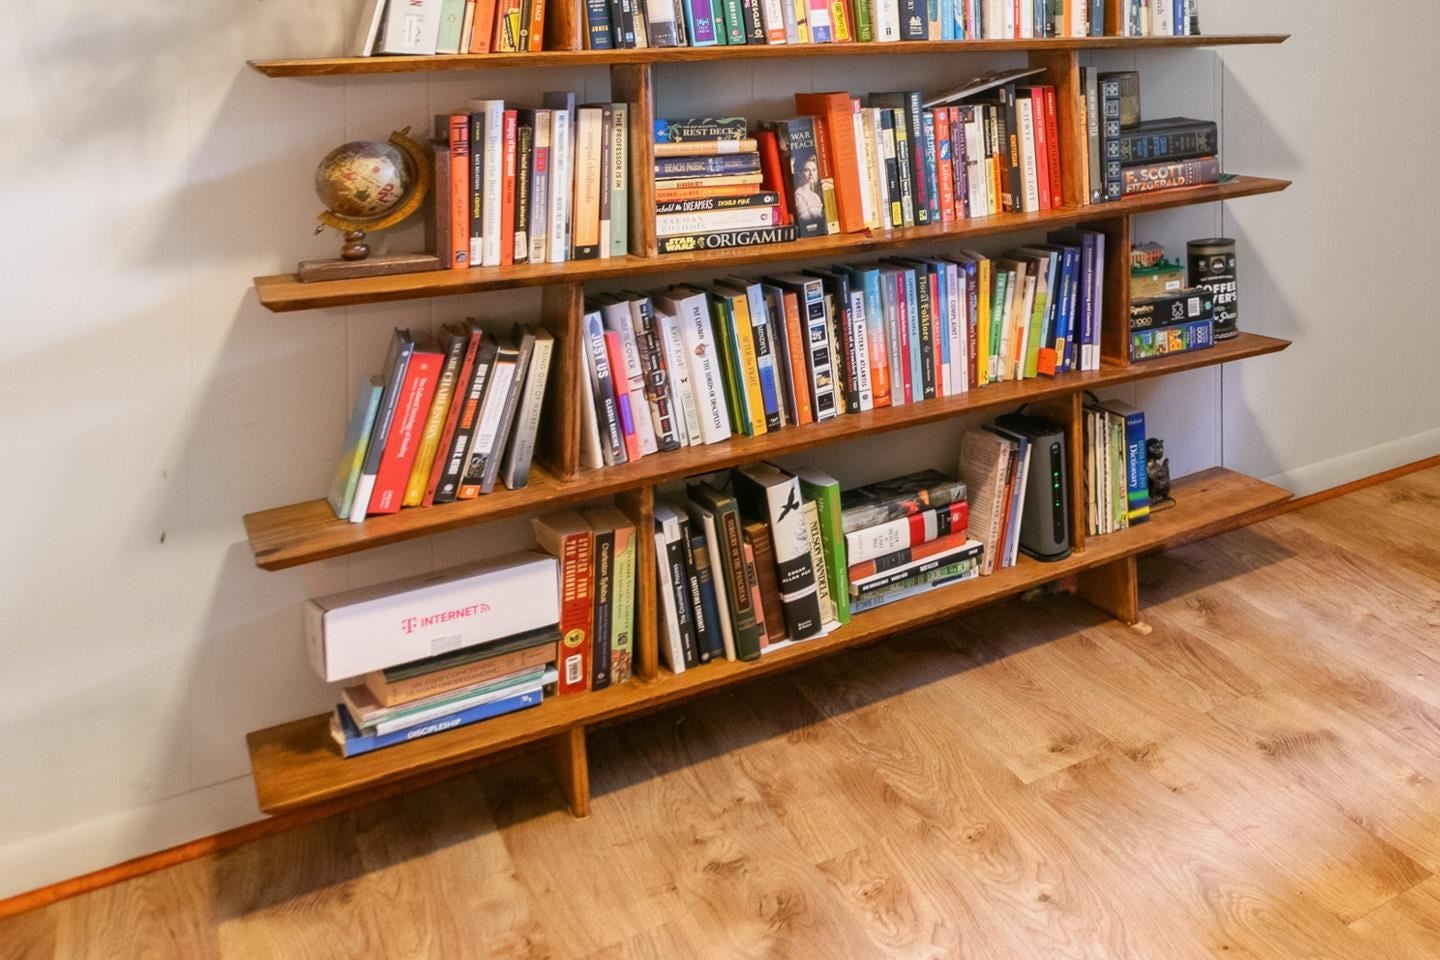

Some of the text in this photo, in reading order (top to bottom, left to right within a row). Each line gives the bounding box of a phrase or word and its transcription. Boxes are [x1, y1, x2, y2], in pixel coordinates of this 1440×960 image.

[534, 5, 543, 21] RACE
[615, 113, 623, 127] THE
[1023, 114, 1031, 141] JEWEL
[683, 128, 709, 137] REST
[709, 127, 735, 136] DECK
[790, 132, 811, 140] WAR
[488, 135, 497, 164] Despite
[615, 129, 623, 170] PROFESSOR
[585, 131, 594, 203] unequal childhoods
[664, 161, 706, 173] BEACH MUSIC
[1125, 170, 1138, 183] F.
[1140, 164, 1185, 181] SCOTT
[489, 179, 497, 196] Best
[615, 180, 623, 188] IN
[1126, 176, 1185, 193] FITZGERALD
[488, 197, 497, 236] Intentions
[683, 199, 714, 212] DREAMERS
[665, 243, 696, 252] WARS
[667, 237, 695, 245] STAR
[706, 229, 782, 248] ORIGAMI
[967, 281, 976, 291] My
[1195, 281, 1236, 294] OFFEE
[693, 306, 701, 317] PAT
[919, 275, 930, 341] Floral Folklore
[694, 317, 704, 341] CONROY
[757, 324, 768, 356] MINDFUL
[857, 324, 865, 352] MASTERS
[590, 332, 609, 379] JUST US
[625, 342, 635, 369] COVER
[702, 359, 711, 371] THE
[742, 335, 752, 357] AFTER
[747, 366, 756, 387] FIGHT
[849, 348, 857, 375] Troubled
[419, 376, 428, 386] The
[704, 371, 714, 390] LORDS
[859, 359, 867, 387] ATLANTIS
[413, 386, 425, 406] Cultural
[427, 342, 462, 440] WE ARE CHARLESTON
[529, 344, 549, 431] RISING OUT OF HATRED
[407, 407, 420, 431] Sociology
[604, 398, 620, 448] CLAUDIA RANKINE
[709, 398, 721, 431] DISCIPLINE
[396, 438, 412, 458] Reading
[1129, 443, 1139, 488] Dictionary
[727, 519, 737, 547] SURGERY
[566, 539, 577, 557] THE
[600, 542, 610, 576] Charleston
[733, 556, 741, 570] THE
[788, 566, 806, 577] EDGAR
[809, 521, 828, 600] NELSON MANDELA
[673, 563, 681, 584] Process
[782, 568, 811, 584] ALLAN POE
[577, 577, 588, 599] FROM
[600, 577, 609, 603] Syllabus
[735, 571, 747, 603] PANCREAS
[674, 585, 685, 613] Counseling
[690, 576, 705, 633] CONTESTING COMMUNITY
[401, 605, 479, 634] T INTERNET
[406, 718, 462, 740] DISCIPLESHIP
